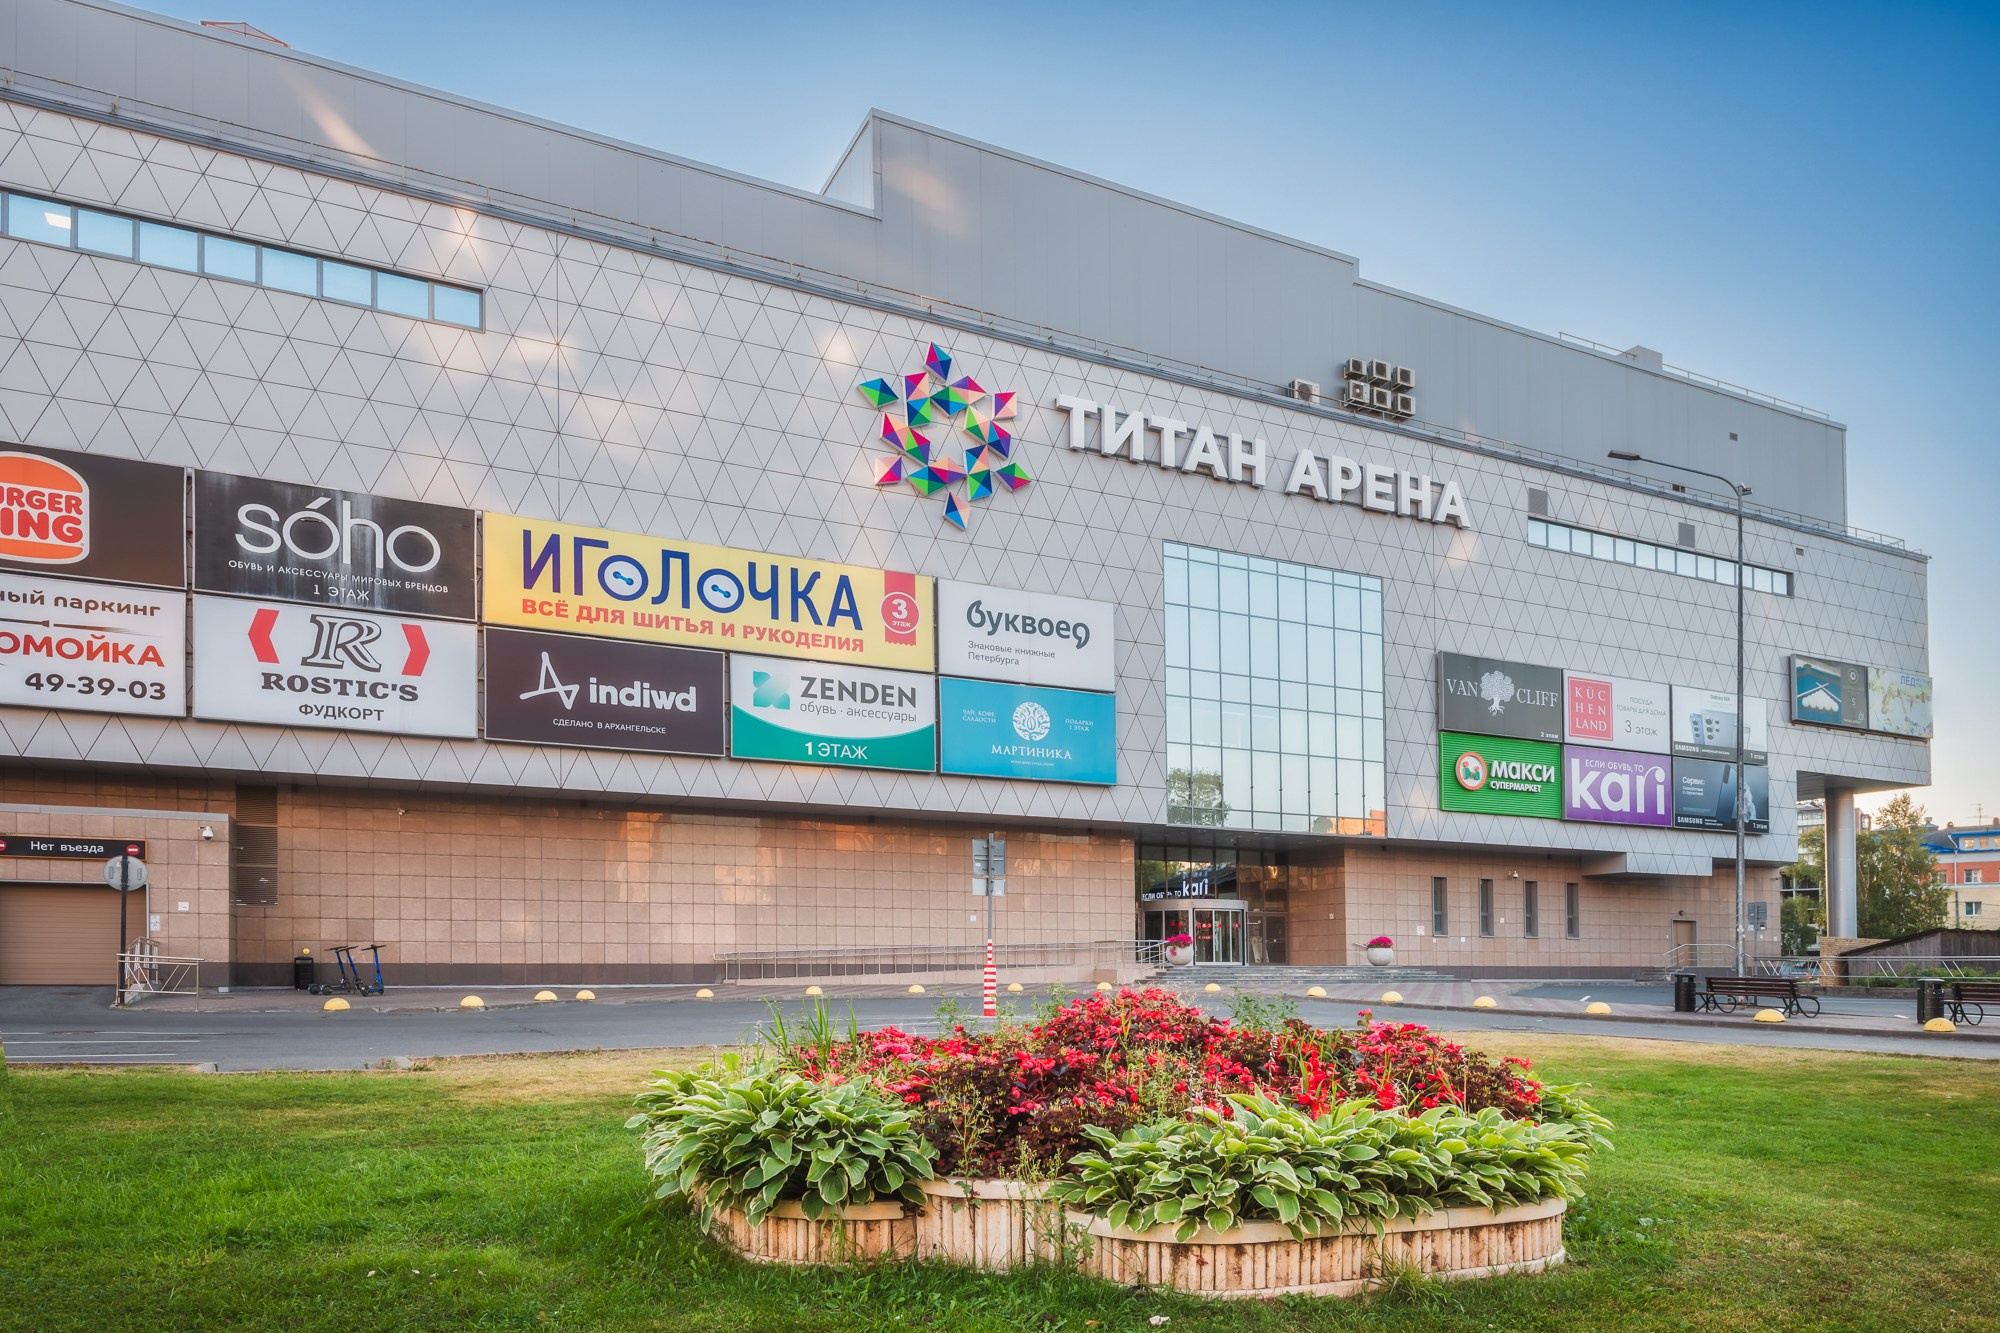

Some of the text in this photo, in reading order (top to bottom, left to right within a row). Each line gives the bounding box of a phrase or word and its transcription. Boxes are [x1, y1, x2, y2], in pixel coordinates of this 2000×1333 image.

[1055, 393, 1472, 529] ТИТАН АРЕНА
[228, 559, 449, 593] ОБУВЬ И АКСЕССУАРЫ МИРОВЫХ БРЕНДОВ
[313, 585, 370, 601] 1 ЭТАЖ
[54, 596, 161, 616] паркинг
[891, 598, 908, 620] 3
[522, 598, 864, 652] ВСЁ ДЛЯ ШИТЬЯ И РУКОДЕЛИЯ
[966, 600, 1091, 650] буквоед
[968, 640, 1056, 658] Знаковые книжные
[968, 652, 1020, 666] Петербурга
[25, 673, 166, 700] 49-39-03
[261, 672, 419, 701] ROSTIC'S
[589, 677, 697, 712] indiwd
[800, 676, 916, 708] ZENDEN
[1446, 678, 1479, 698] VAN
[1516, 688, 1559, 707] CLIFF
[299, 704, 384, 721] ФУДКОРТ
[799, 702, 917, 723] обувь аксессуары
[552, 718, 593, 728] СДЕЛАНО
[605, 722, 667, 734] АРХАНГЕЛЬСКЕ
[1575, 717, 1607, 731] LAND
[1625, 719, 1658, 736] 3 этаж
[805, 741, 868, 760] 1 ЭТАЖ
[991, 744, 1072, 760] МАРТИНИКА
[1675, 744, 1699, 753] SAMSUNG
[1585, 759, 1644, 772] ЕСЛИ ОБУВЬ, ТО
[1490, 781, 1541, 793] СУПЕРМАРКЕТ
[1571, 757, 1665, 815] kari
[1677, 816, 1703, 825] SAMSUNG
[30, 841, 104, 854] Нет въезда
[1182, 878, 1209, 897] kari
